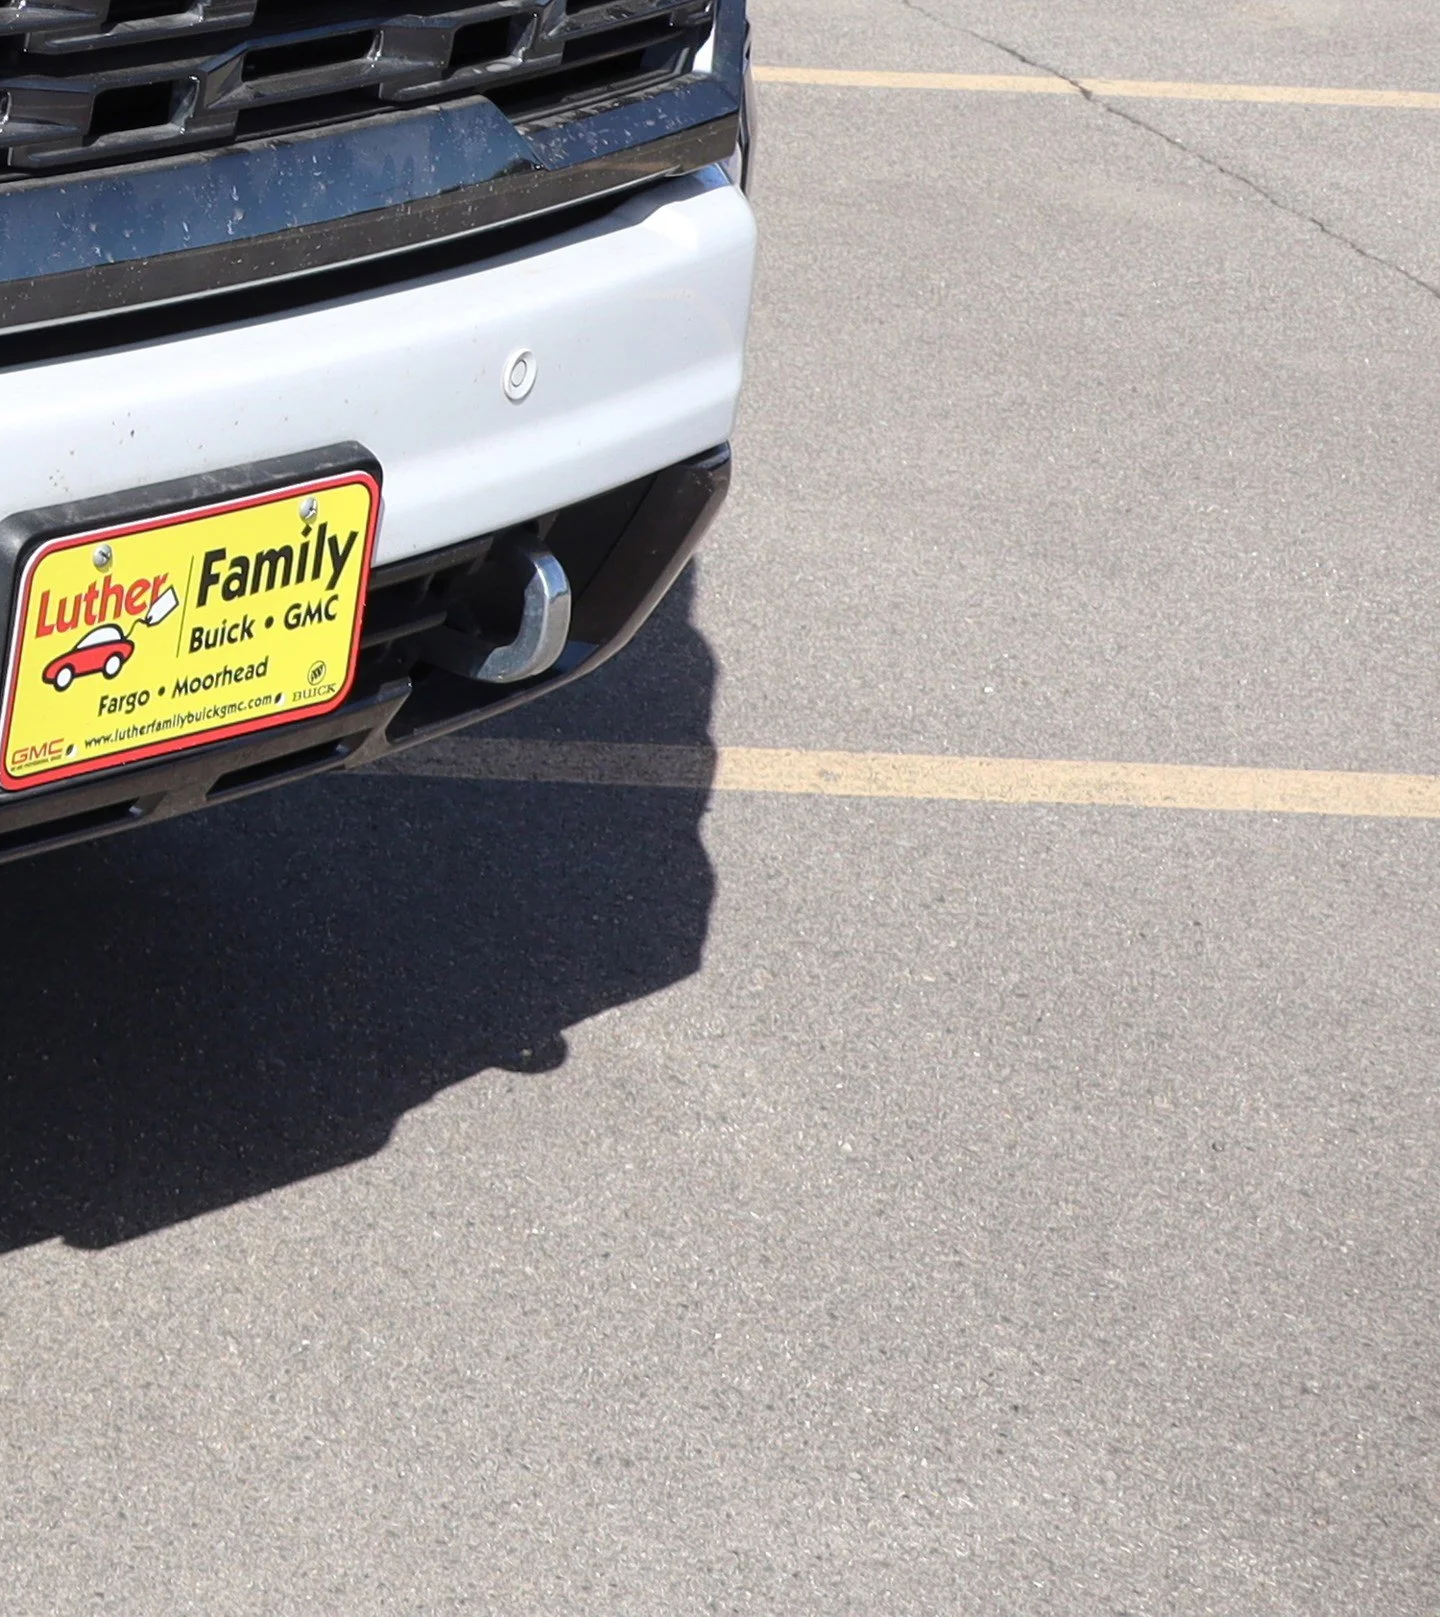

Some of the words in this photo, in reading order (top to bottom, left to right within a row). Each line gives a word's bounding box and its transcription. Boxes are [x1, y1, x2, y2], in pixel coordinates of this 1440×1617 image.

[196, 522, 359, 608] Family
[35, 572, 169, 638] Luther
[188, 614, 256, 654] Buick
[284, 594, 339, 631] GMC
[97, 686, 150, 717] Fargo
[171, 656, 269, 699] Moorhead
[292, 682, 336, 702] BUICK
[12, 738, 64, 765] GMC
[85, 694, 273, 750] www.lutherfamilybuickgmc.com
